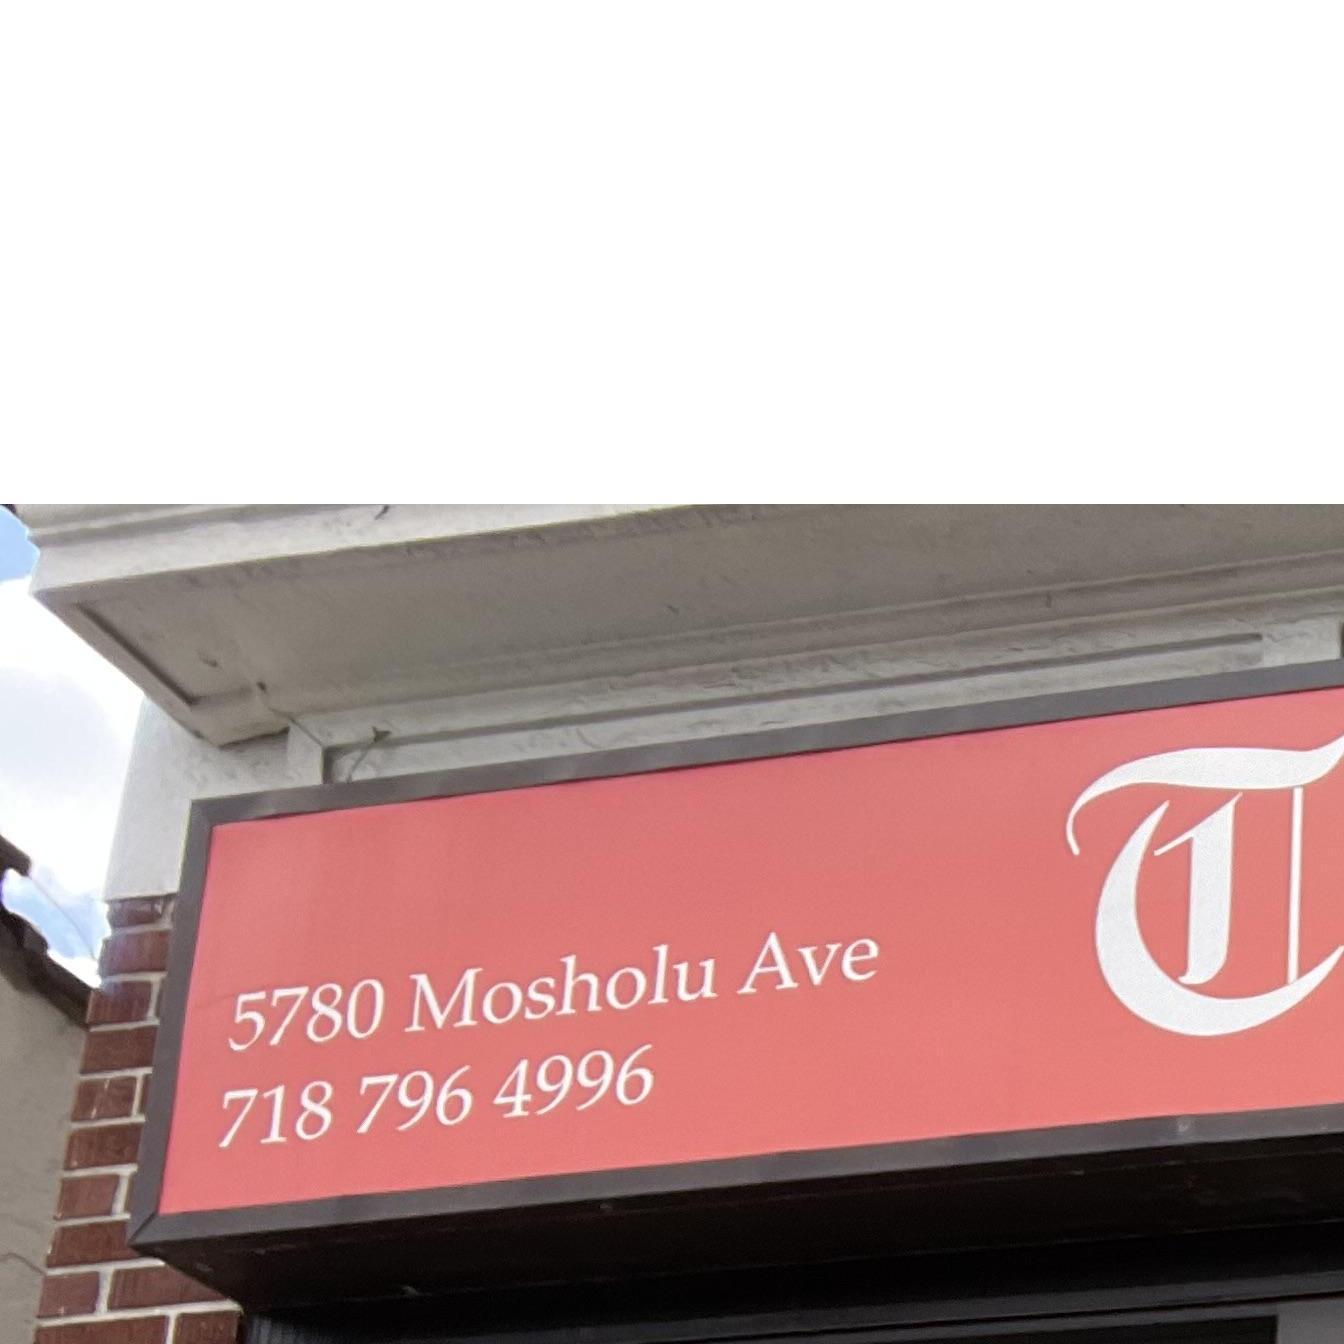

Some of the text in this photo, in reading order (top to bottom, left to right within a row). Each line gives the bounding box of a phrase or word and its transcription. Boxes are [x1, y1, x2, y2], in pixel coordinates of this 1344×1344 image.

[230, 933, 878, 1050] 5780 Mosholu Ave
[220, 1045, 653, 1147] 718 796 4996
